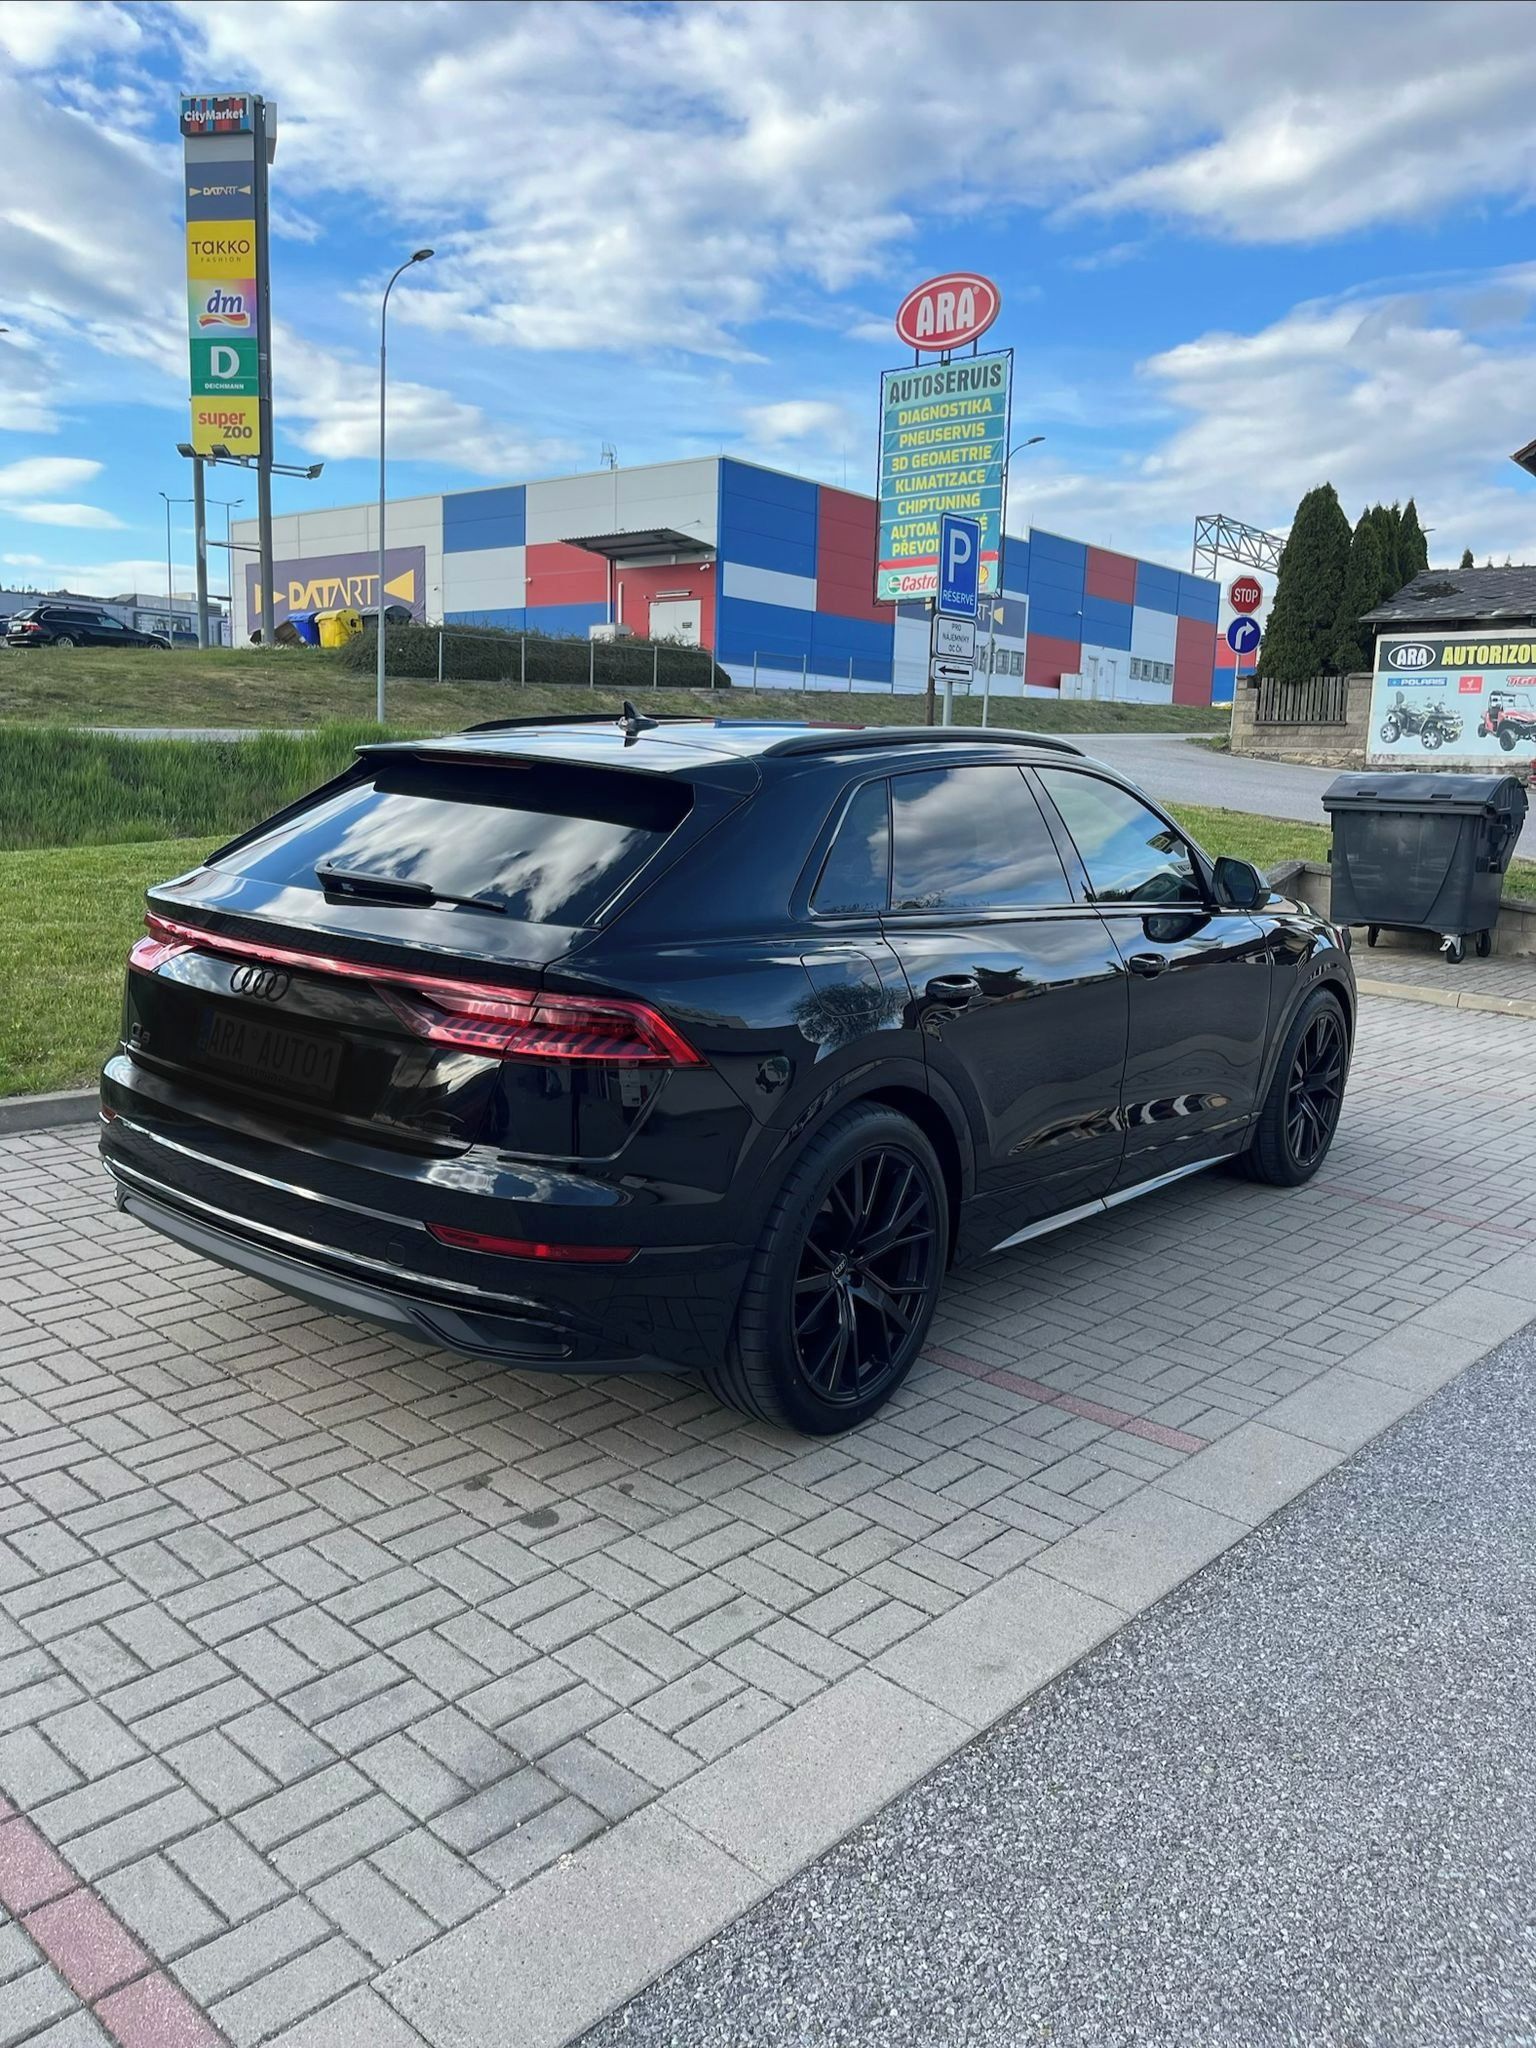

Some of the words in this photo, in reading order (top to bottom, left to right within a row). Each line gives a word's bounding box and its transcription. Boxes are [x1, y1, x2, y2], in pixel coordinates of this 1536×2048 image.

[184, 108, 244, 124] CityMarket
[202, 185, 238, 196] DATART
[206, 289, 243, 314] dm
[915, 286, 976, 338] ARA
[210, 345, 240, 379] D
[204, 382, 245, 390] DEICHMANN
[889, 363, 1002, 405] AUTOSERVIS
[198, 411, 246, 429] super
[898, 397, 993, 426] DIAGNOSTIKA
[223, 426, 253, 439] zoo
[899, 422, 986, 448] PNEUSERVIS
[891, 456, 909, 472] 3D
[911, 445, 993, 469] GEOMETRIE
[895, 469, 986, 494] KLIMATIZACE
[897, 492, 981, 516] CHIPTUNING
[948, 528, 972, 583] P
[288, 574, 380, 610] DATART
[901, 574, 938, 592] Castro
[1234, 587, 1259, 603] STOP
[1396, 648, 1428, 666] ARA
[1401, 678, 1446, 686] POLARIS
[208, 1018, 246, 1060] ARA
[257, 1031, 335, 1084] AUTO1
